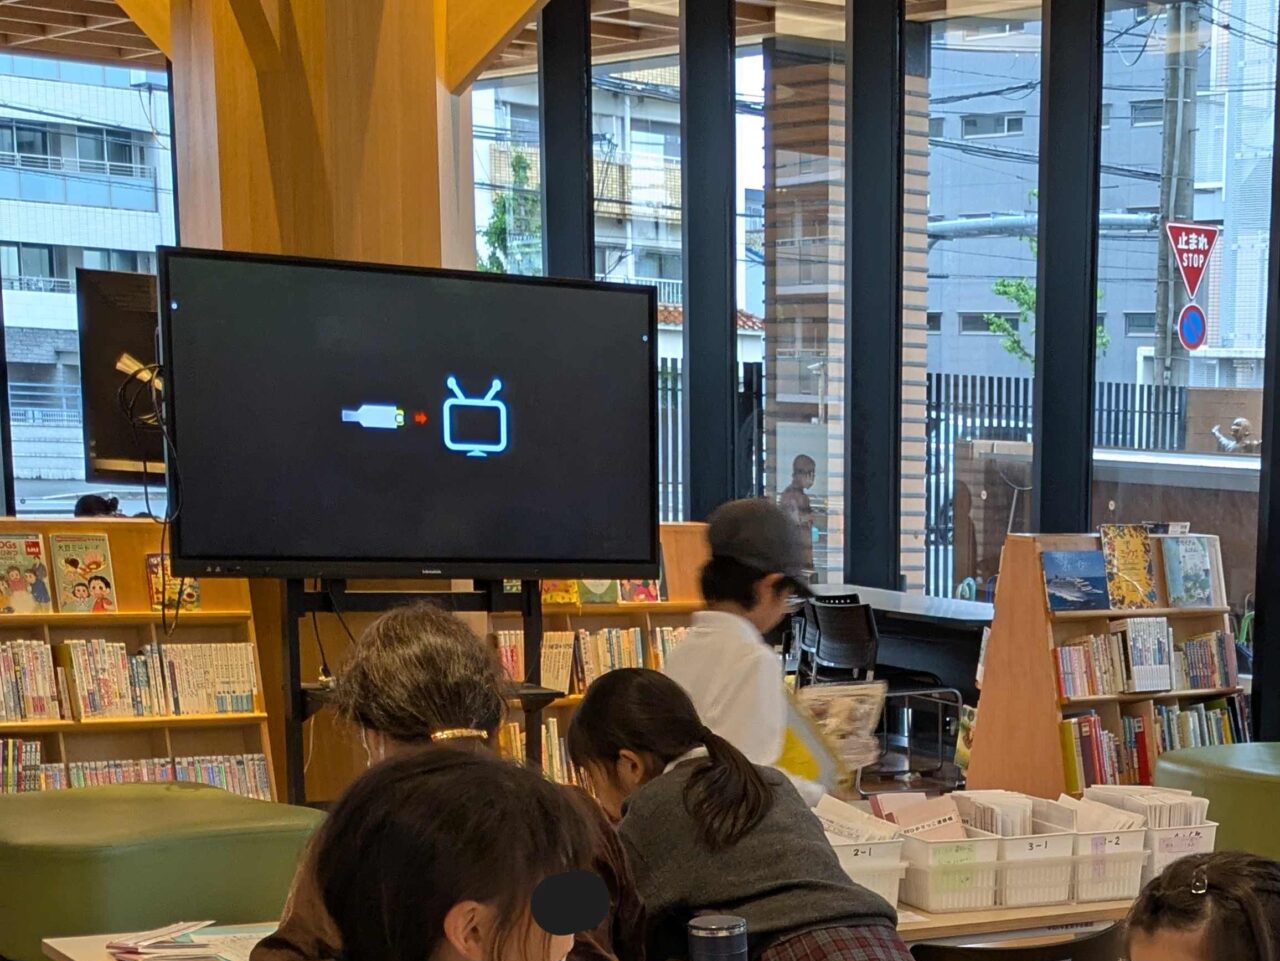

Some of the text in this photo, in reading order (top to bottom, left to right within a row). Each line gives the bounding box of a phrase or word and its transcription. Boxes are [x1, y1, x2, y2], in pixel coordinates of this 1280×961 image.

[1177, 231, 1209, 250] 止まれ
[1183, 252, 1205, 268] STOP
[1028, 840, 1048, 850] 3-1
[853, 847, 872, 857] 2-1
